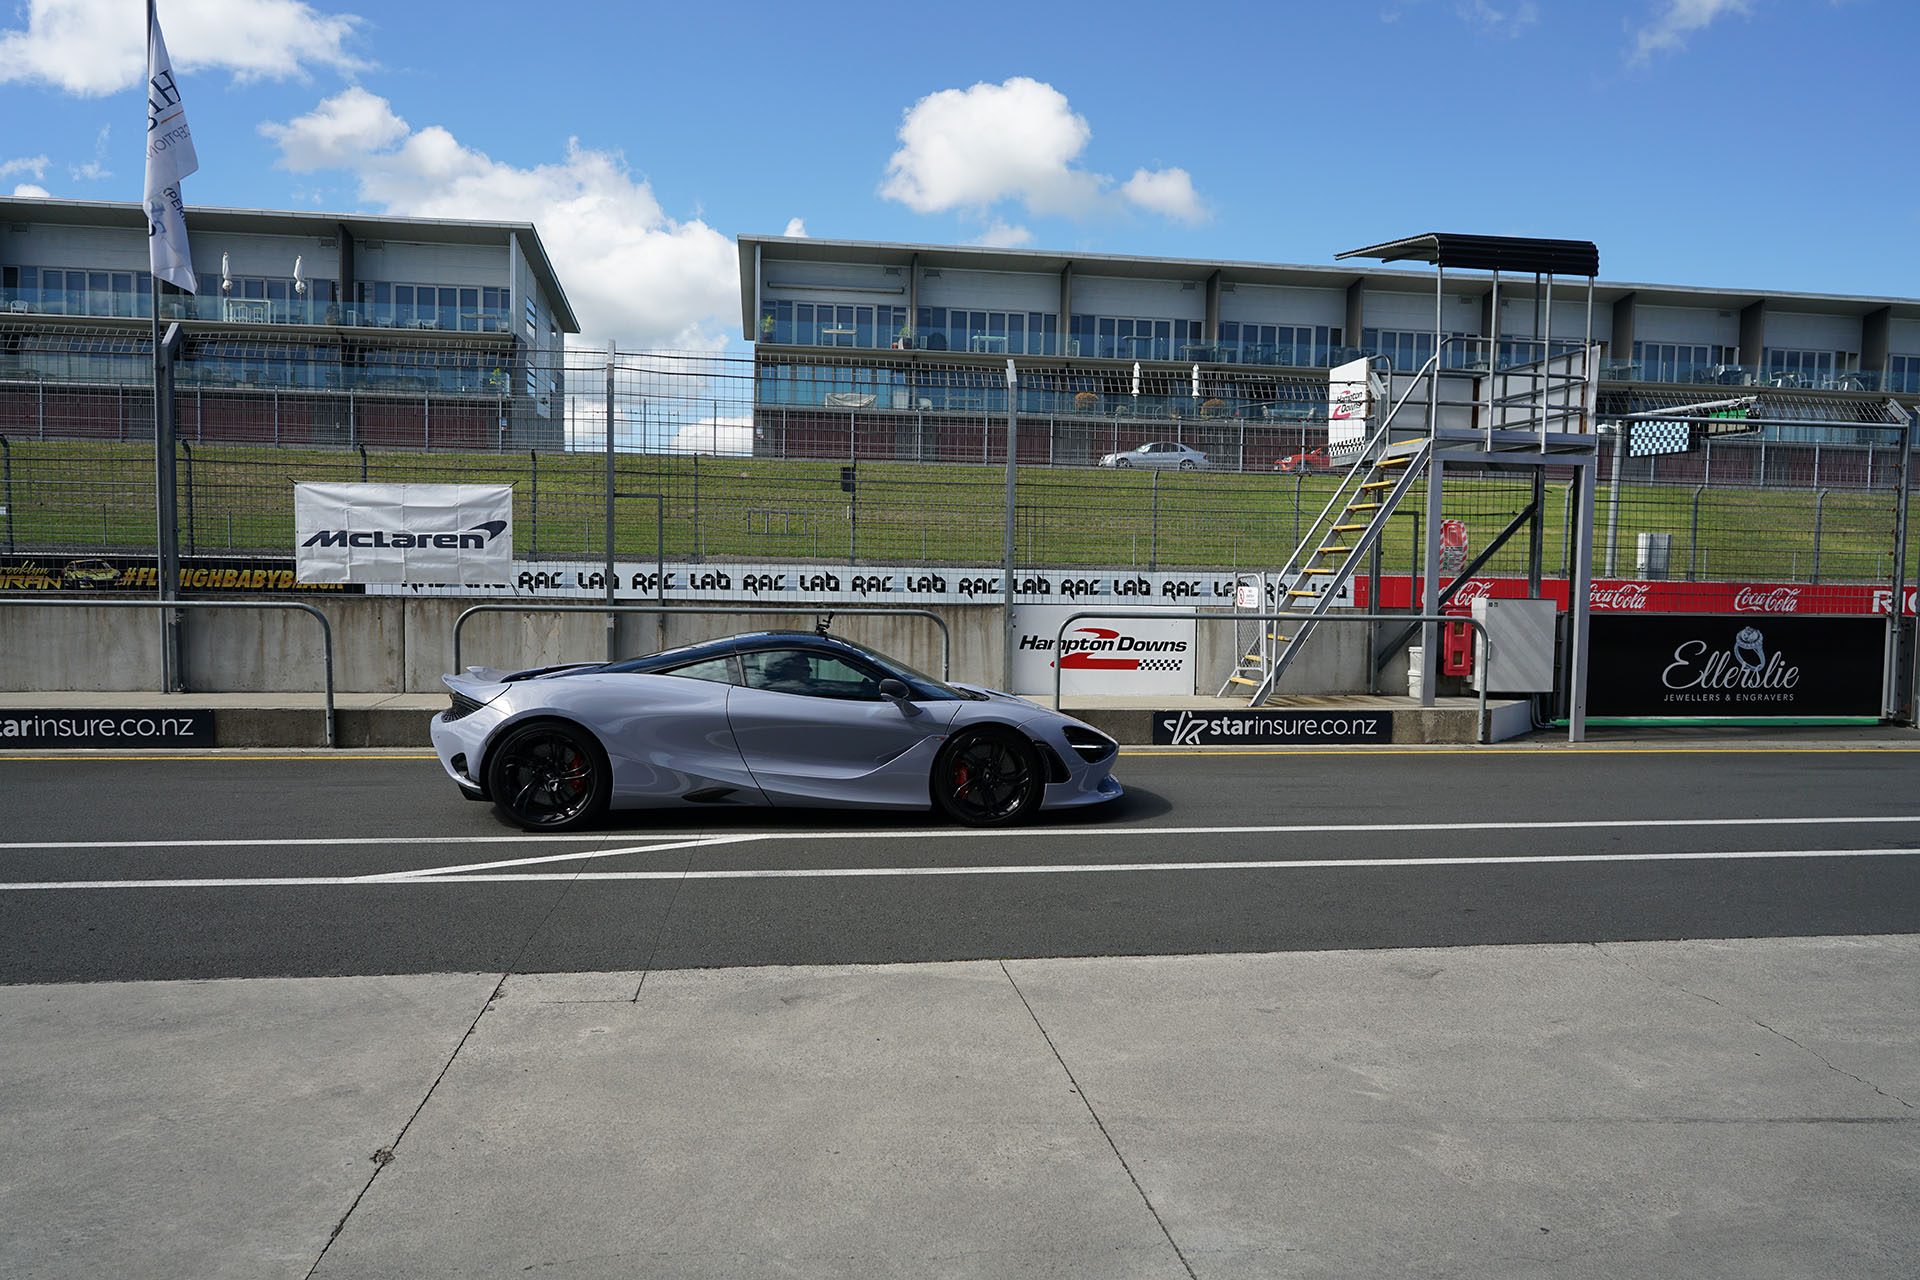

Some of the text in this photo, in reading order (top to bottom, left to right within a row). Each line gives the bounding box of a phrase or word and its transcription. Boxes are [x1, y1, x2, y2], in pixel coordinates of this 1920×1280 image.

[301, 530, 484, 549] McLaren
[1019, 635, 1188, 654] Hampton Downs
[1661, 640, 1800, 690] Ellerslie
[1664, 693, 1795, 702] JEWELLERS & ENGRAVERS
[1209, 716, 1377, 736] starinsure.co.nz
